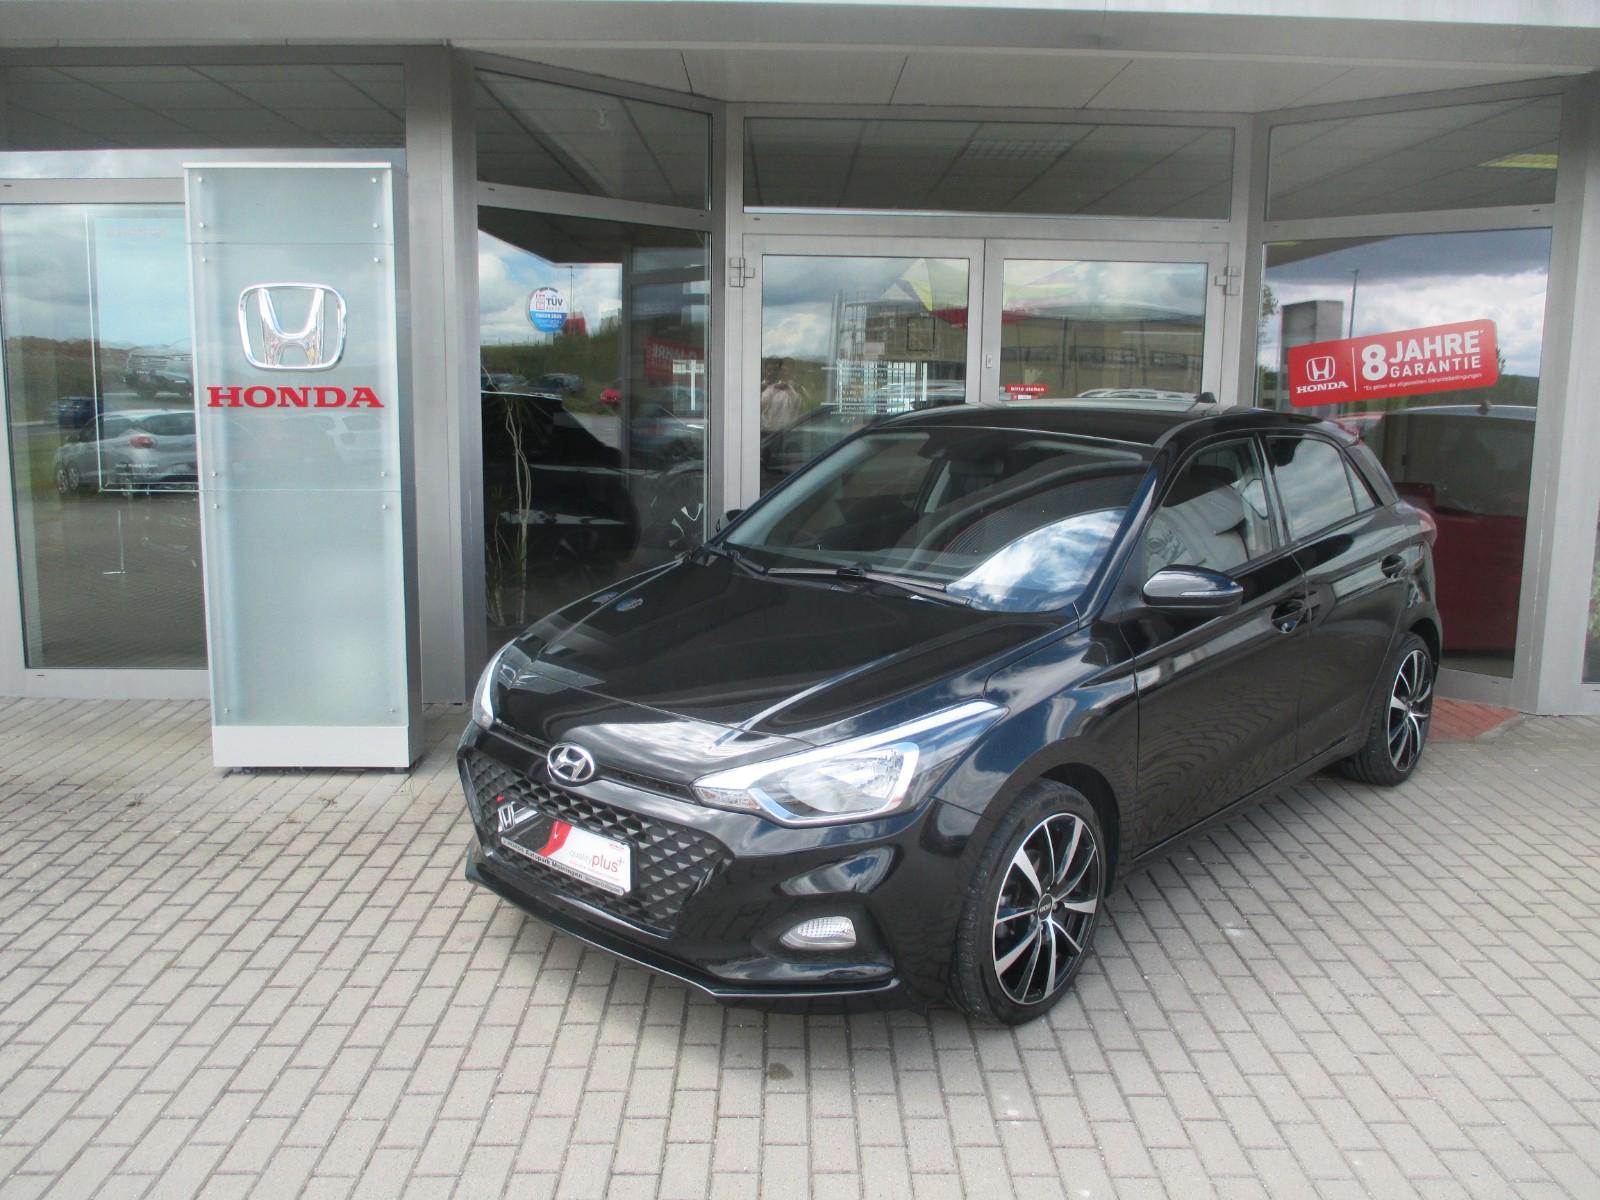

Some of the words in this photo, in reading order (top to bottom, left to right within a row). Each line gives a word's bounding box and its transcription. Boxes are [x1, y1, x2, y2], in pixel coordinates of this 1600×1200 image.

[546, 295, 563, 306] TÜV
[1361, 344, 1389, 381] 8
[1390, 355, 1481, 379] GARANTIE
[207, 386, 384, 408] HONDA
[1296, 380, 1349, 394] HONDA
